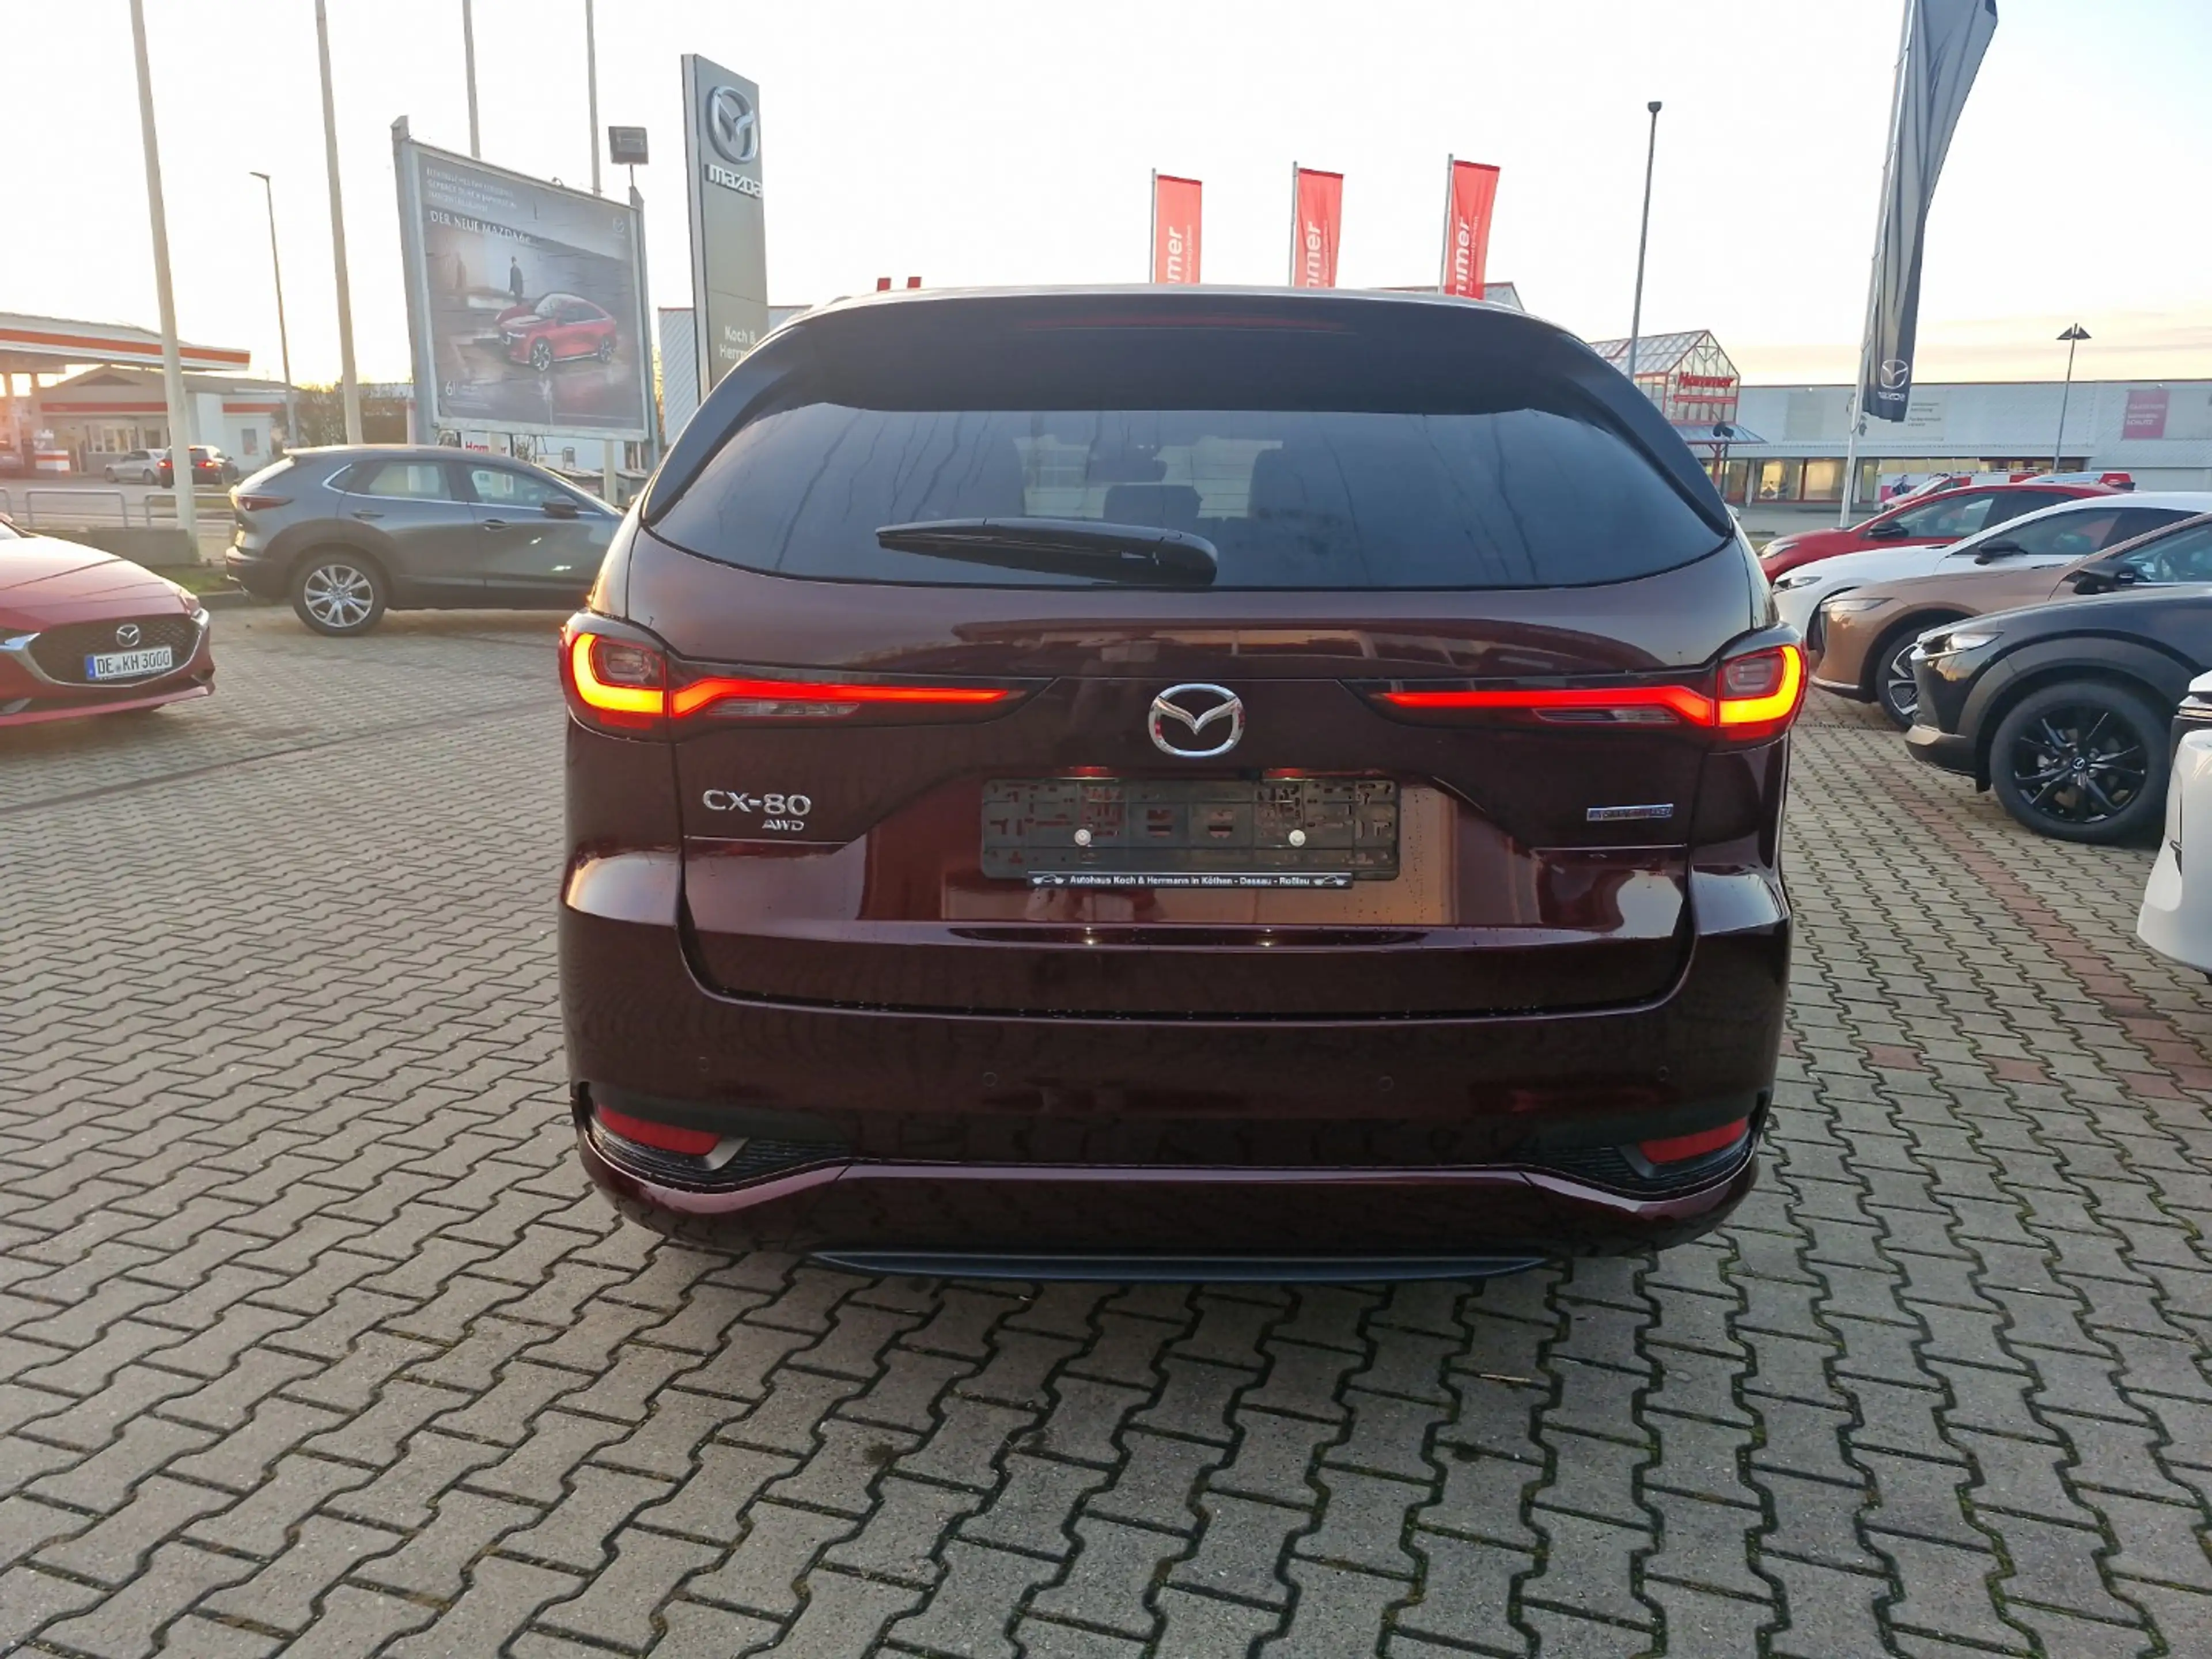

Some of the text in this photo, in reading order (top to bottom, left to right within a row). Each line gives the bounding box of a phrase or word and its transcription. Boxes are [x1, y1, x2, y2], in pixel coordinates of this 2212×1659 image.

[709, 164, 763, 199] mazda
[430, 210, 450, 226] DER
[454, 217, 479, 233] NEUE
[724, 325, 748, 343] Koch
[97, 650, 171, 675] DE KH 3000
[702, 788, 812, 817] CX-80
[762, 818, 805, 831] AWD
[1069, 875, 1112, 885] Autohaus
[1113, 875, 1136, 885] Koch
[1138, 876, 1145, 885] &
[1147, 876, 1190, 885] Herrmann
[1191, 876, 1199, 885] in
[1201, 876, 1233, 886] Köthen
[1240, 877, 1271, 886] Dessau
